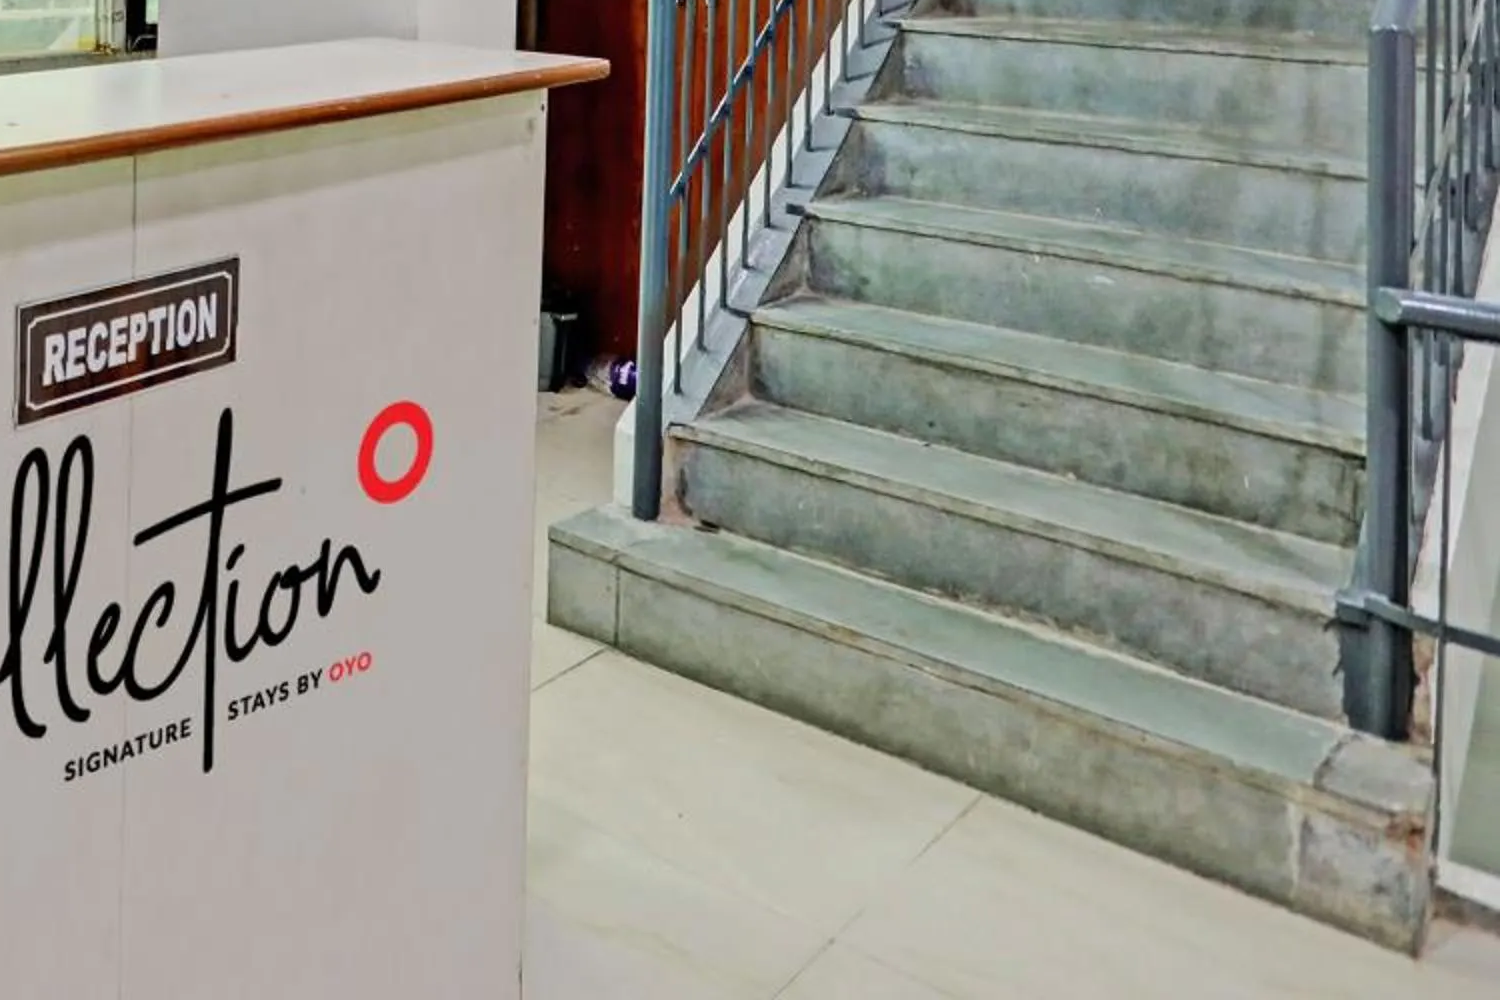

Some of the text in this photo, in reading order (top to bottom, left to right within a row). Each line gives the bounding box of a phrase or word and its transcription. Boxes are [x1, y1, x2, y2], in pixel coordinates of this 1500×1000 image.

[42, 292, 217, 386] RECEPTION
[63, 651, 373, 782] SIGNATURE STAYS BY OYO
